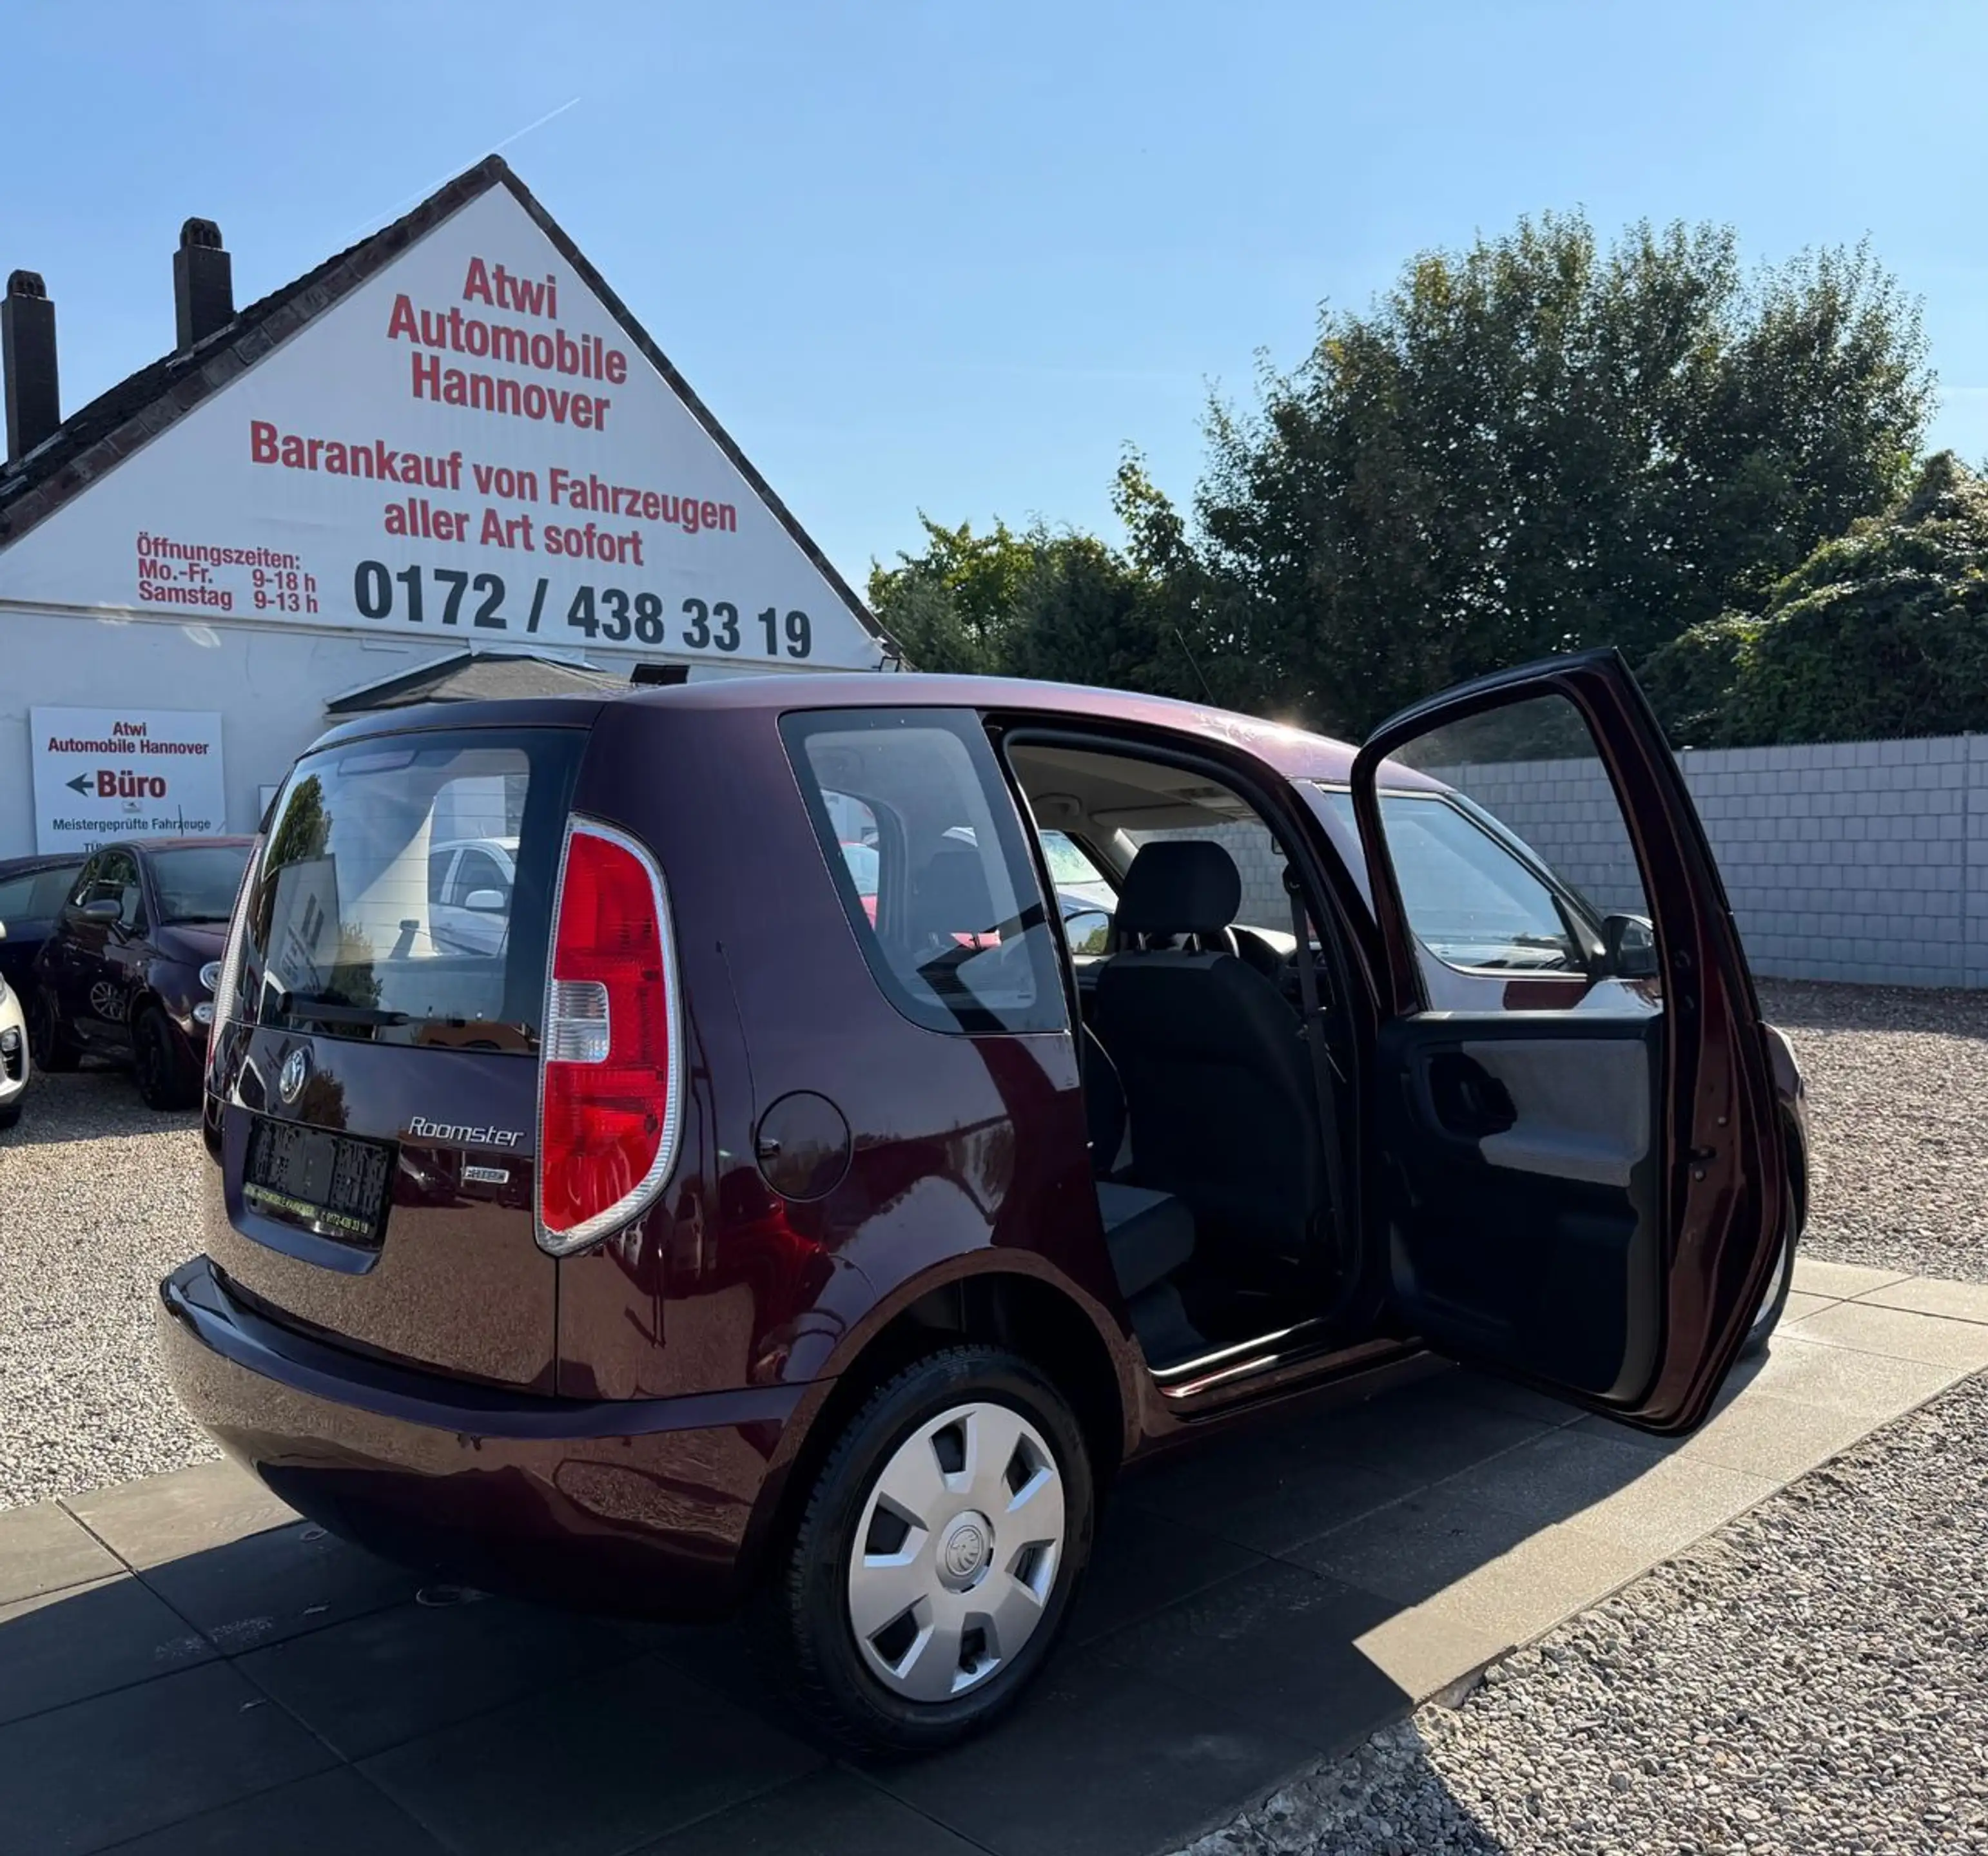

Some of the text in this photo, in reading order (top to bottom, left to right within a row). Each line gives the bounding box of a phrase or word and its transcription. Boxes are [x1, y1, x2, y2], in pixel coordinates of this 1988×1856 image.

[463, 256, 557, 320] Atwi
[387, 293, 627, 385] Automobile
[411, 351, 610, 431] Hannover
[250, 420, 738, 535] Barankauf von Fahrzeugen
[384, 497, 645, 566] aller Art sofort
[137, 532, 301, 570] Öffnungszeiten:
[138, 558, 316, 593] Mo.-Fr. 9-18 h
[139, 580, 318, 614] Samstag 9-13 h
[353, 559, 812, 659] 0172 / 438 33 19
[48, 737, 209, 755] Automobile Hannover
[113, 721, 146, 737] Atwi
[97, 769, 166, 798] Büro
[53, 818, 211, 833] Meistergeprüfte Fahrzeuge
[407, 1116, 523, 1147] Roomster
